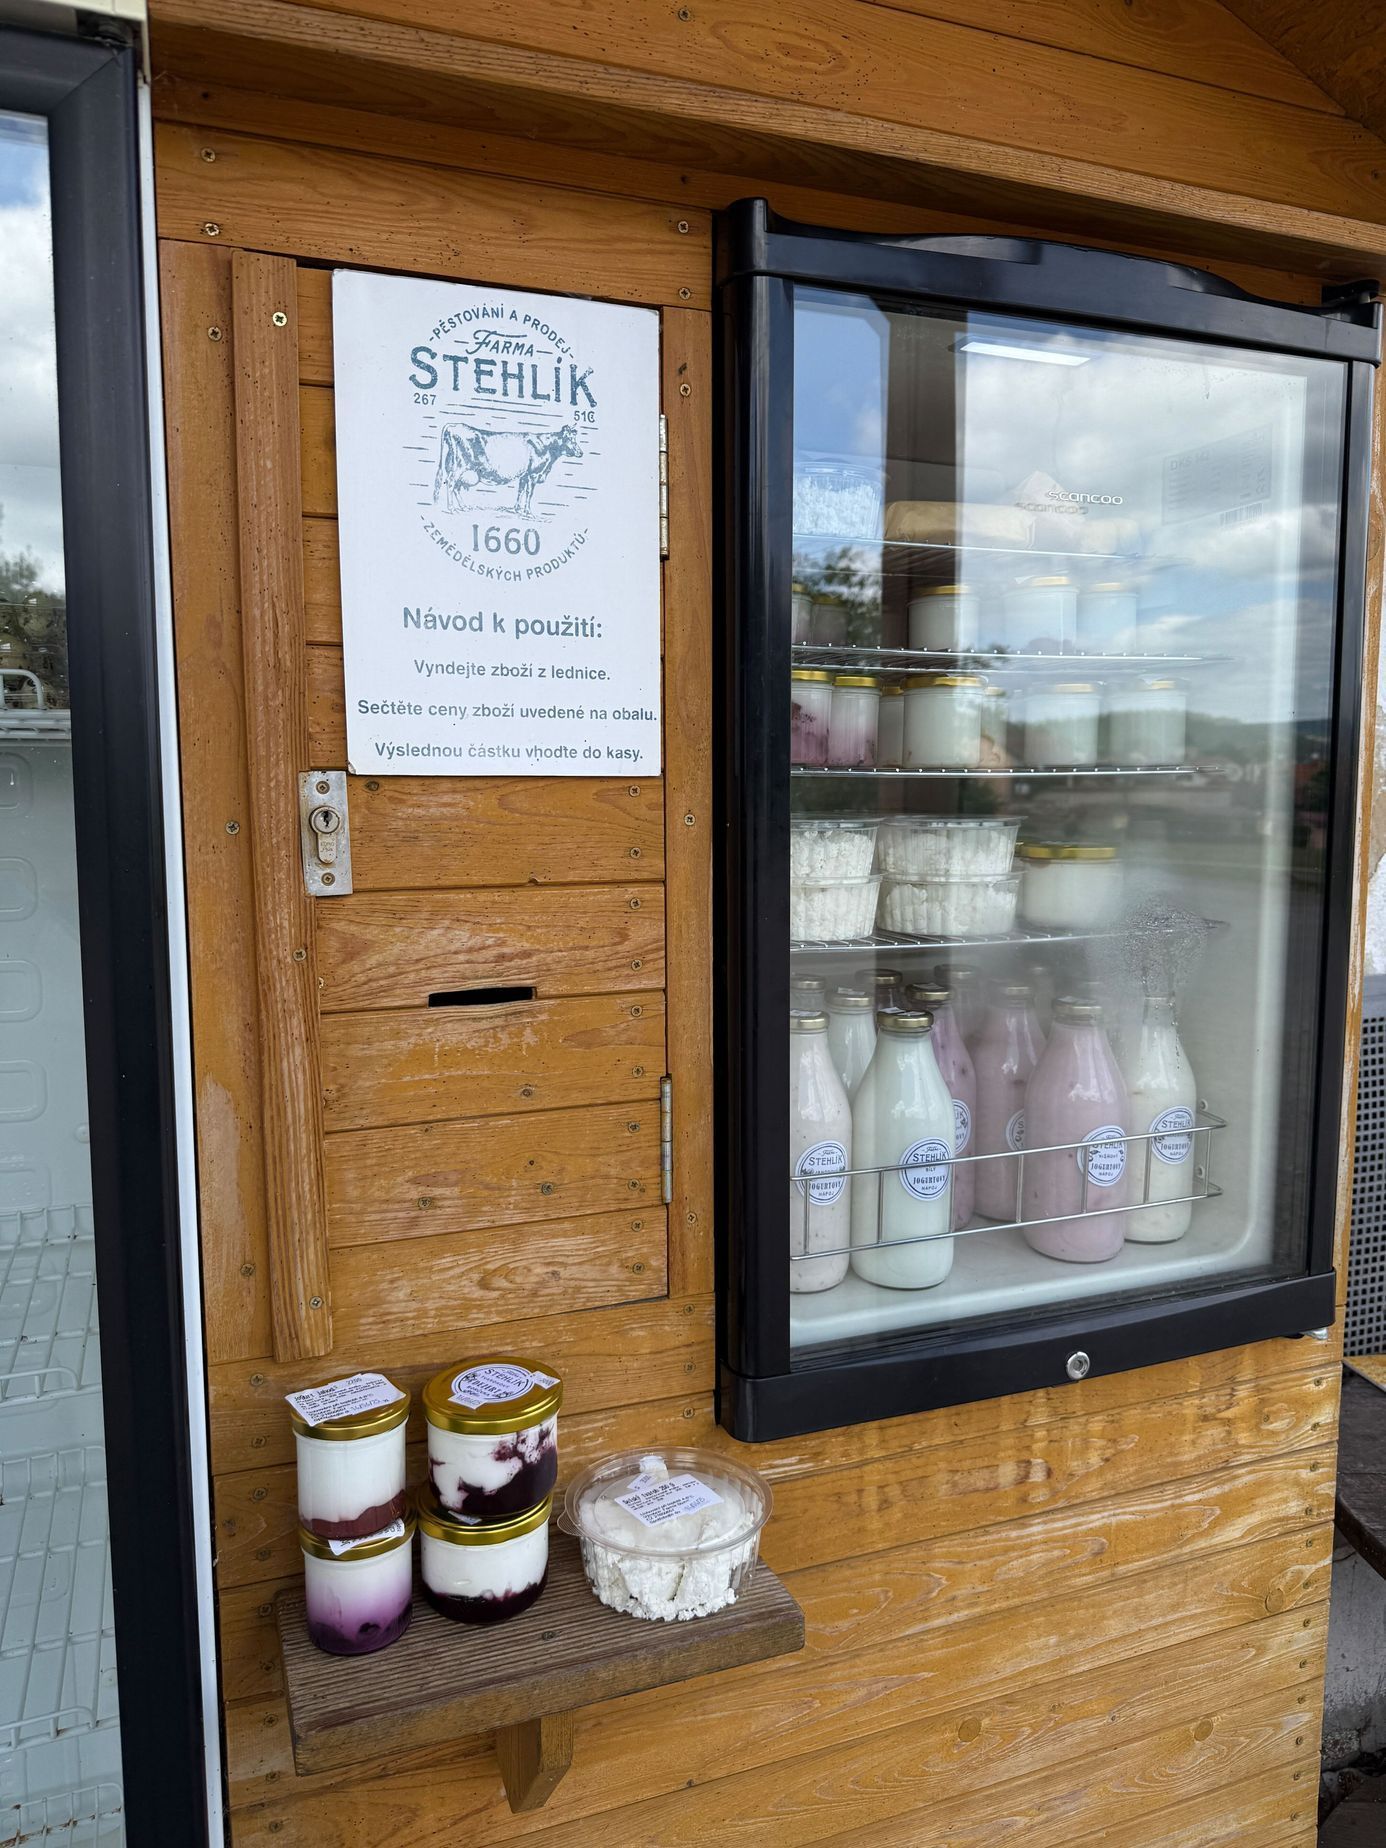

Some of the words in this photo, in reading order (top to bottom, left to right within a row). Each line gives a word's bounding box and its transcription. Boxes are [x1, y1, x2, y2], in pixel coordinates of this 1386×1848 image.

[510, 310, 518, 321] A
[465, 329, 534, 357] FARMA
[408, 346, 598, 408] STEHLÍK
[413, 392, 437, 406] 267
[472, 524, 541, 556] 1660
[402, 606, 484, 633] Návod
[492, 612, 506, 634] k
[514, 614, 603, 640] použití:
[414, 659, 486, 678] Vyndejte
[490, 662, 533, 678] zboží
[538, 667, 546, 678] z
[551, 665, 611, 681] lednice.
[358, 699, 423, 716] Sečtěte
[428, 704, 467, 720] ceny
[472, 703, 515, 718] zboží
[520, 704, 585, 720] uvedené
[590, 708, 607, 720] na
[612, 707, 657, 721] obalu.
[374, 741, 462, 760] Výslednou
[468, 742, 520, 758] částku
[582, 746, 602, 758] do
[606, 746, 644, 762] kasy.
